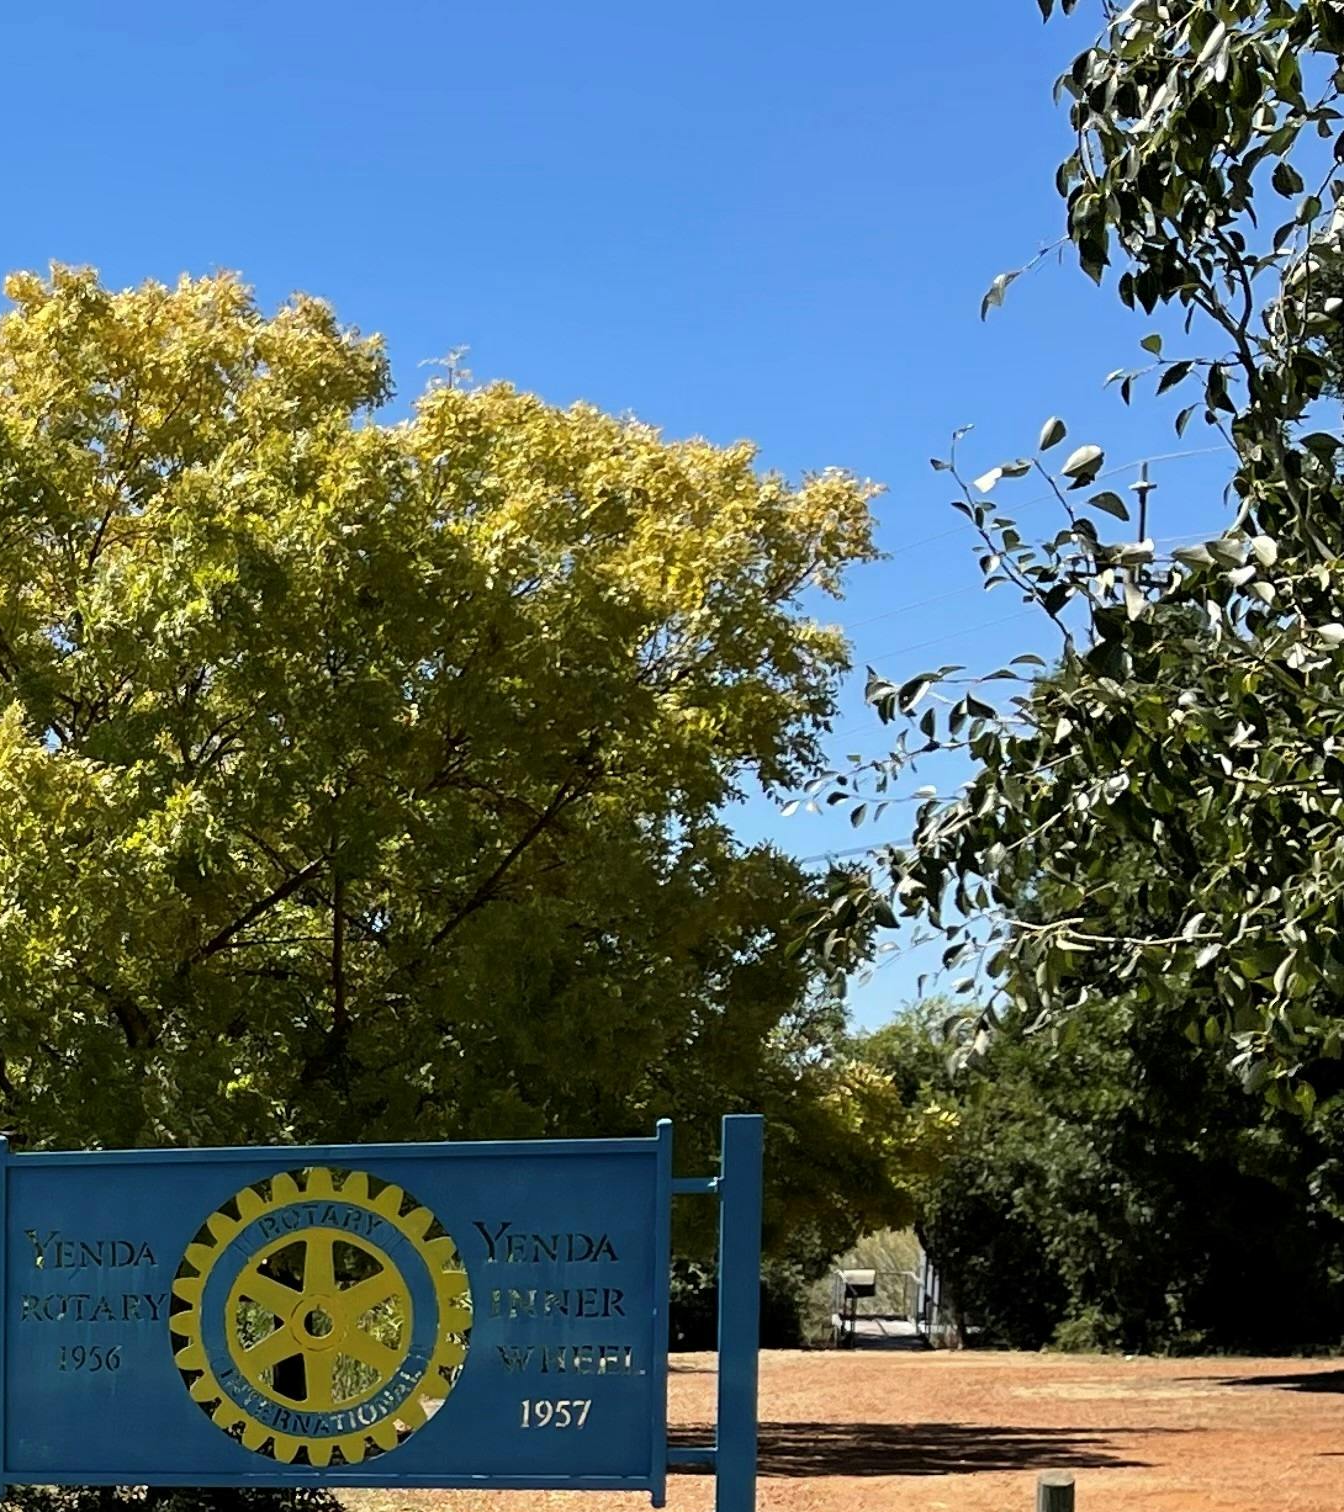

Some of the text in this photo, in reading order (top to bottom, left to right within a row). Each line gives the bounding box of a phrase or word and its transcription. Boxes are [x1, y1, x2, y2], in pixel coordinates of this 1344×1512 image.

[261, 1204, 384, 1239] ROTARY
[24, 1229, 158, 1270] YENDA
[473, 1221, 619, 1263] YENDA
[20, 1293, 169, 1322] ROTARY
[489, 1287, 626, 1318] INNER
[59, 1345, 123, 1373] 1956
[496, 1344, 647, 1376] WHEEL
[220, 1367, 422, 1434] INTERNATIONAL
[520, 1399, 592, 1430] 1957
